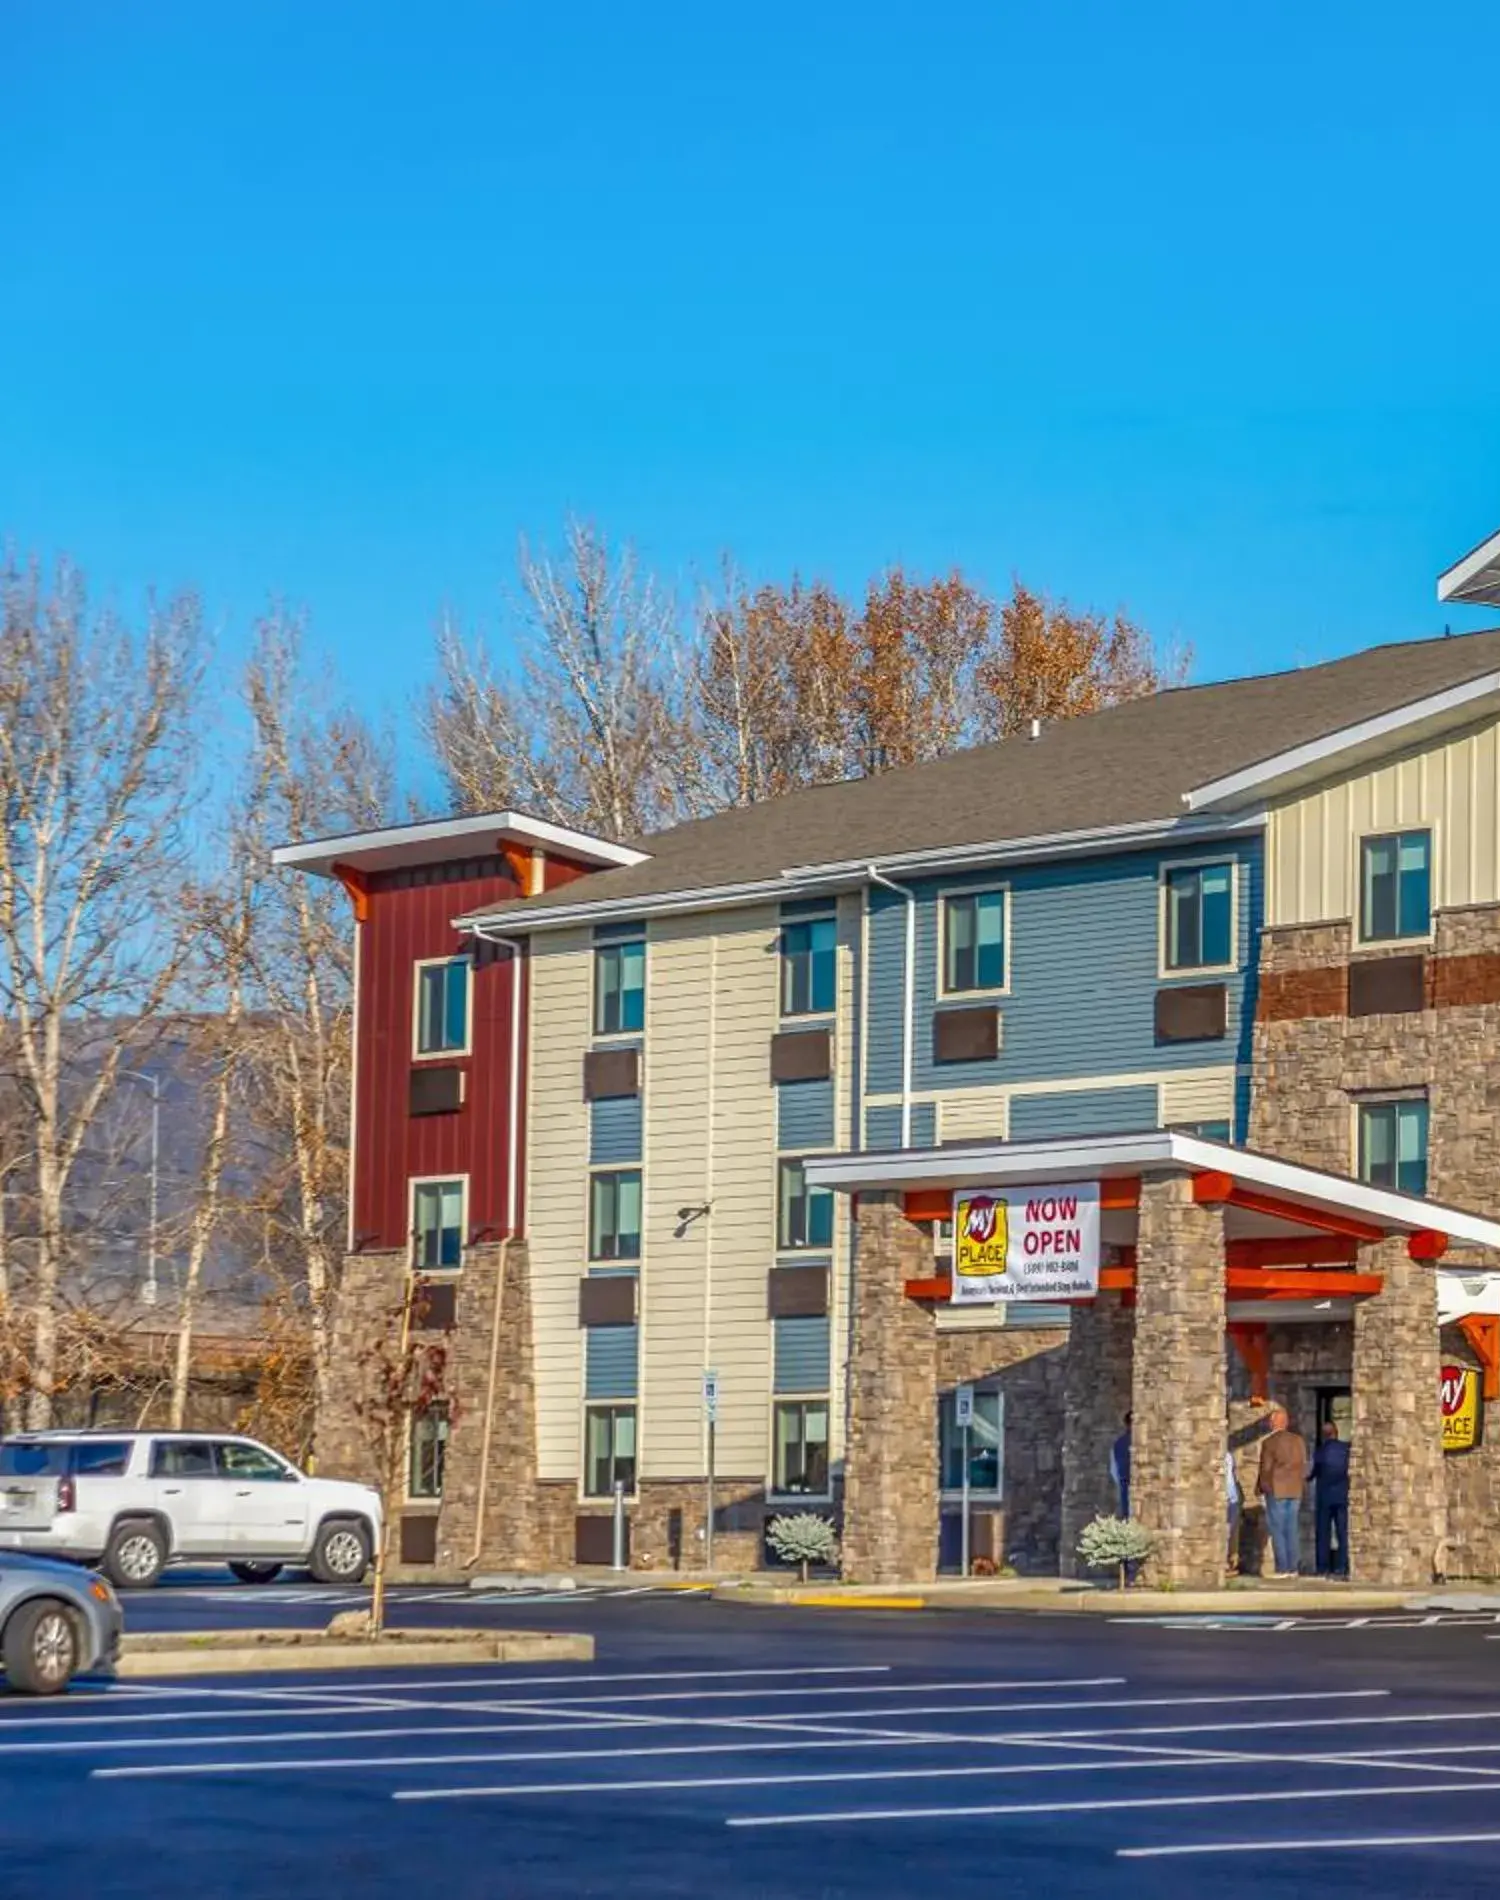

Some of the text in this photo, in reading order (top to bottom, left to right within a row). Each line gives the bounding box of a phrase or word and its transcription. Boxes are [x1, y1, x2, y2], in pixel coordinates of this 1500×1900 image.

[1025, 1196, 1077, 1222] NOW
[1023, 1229, 1081, 1255] OPEN
[959, 1245, 1003, 1262] PLACE
[1443, 1417, 1471, 1434] ACE
